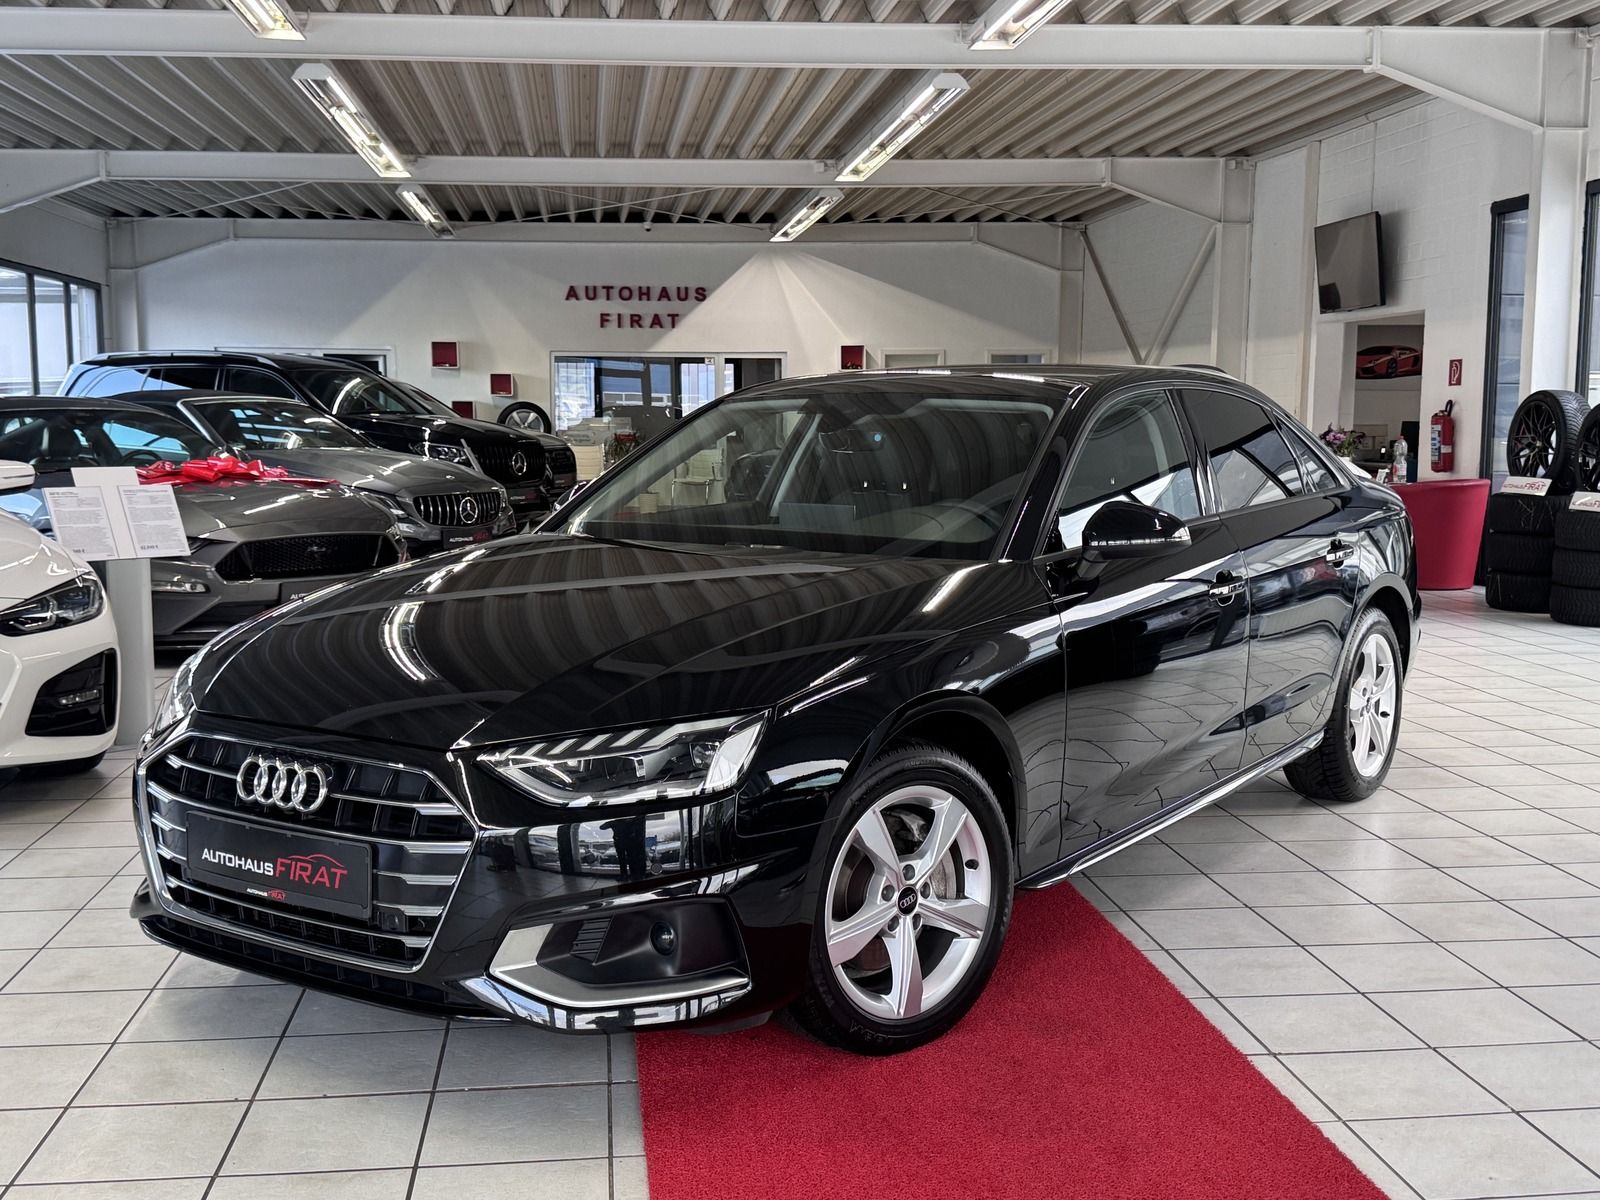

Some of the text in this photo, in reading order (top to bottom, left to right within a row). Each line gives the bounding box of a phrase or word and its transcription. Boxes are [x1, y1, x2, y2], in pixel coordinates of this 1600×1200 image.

[565, 285, 708, 302] AUTOHAUS
[600, 313, 679, 329] FIRAT
[201, 847, 348, 889] AUTOHAUS FIRAT
